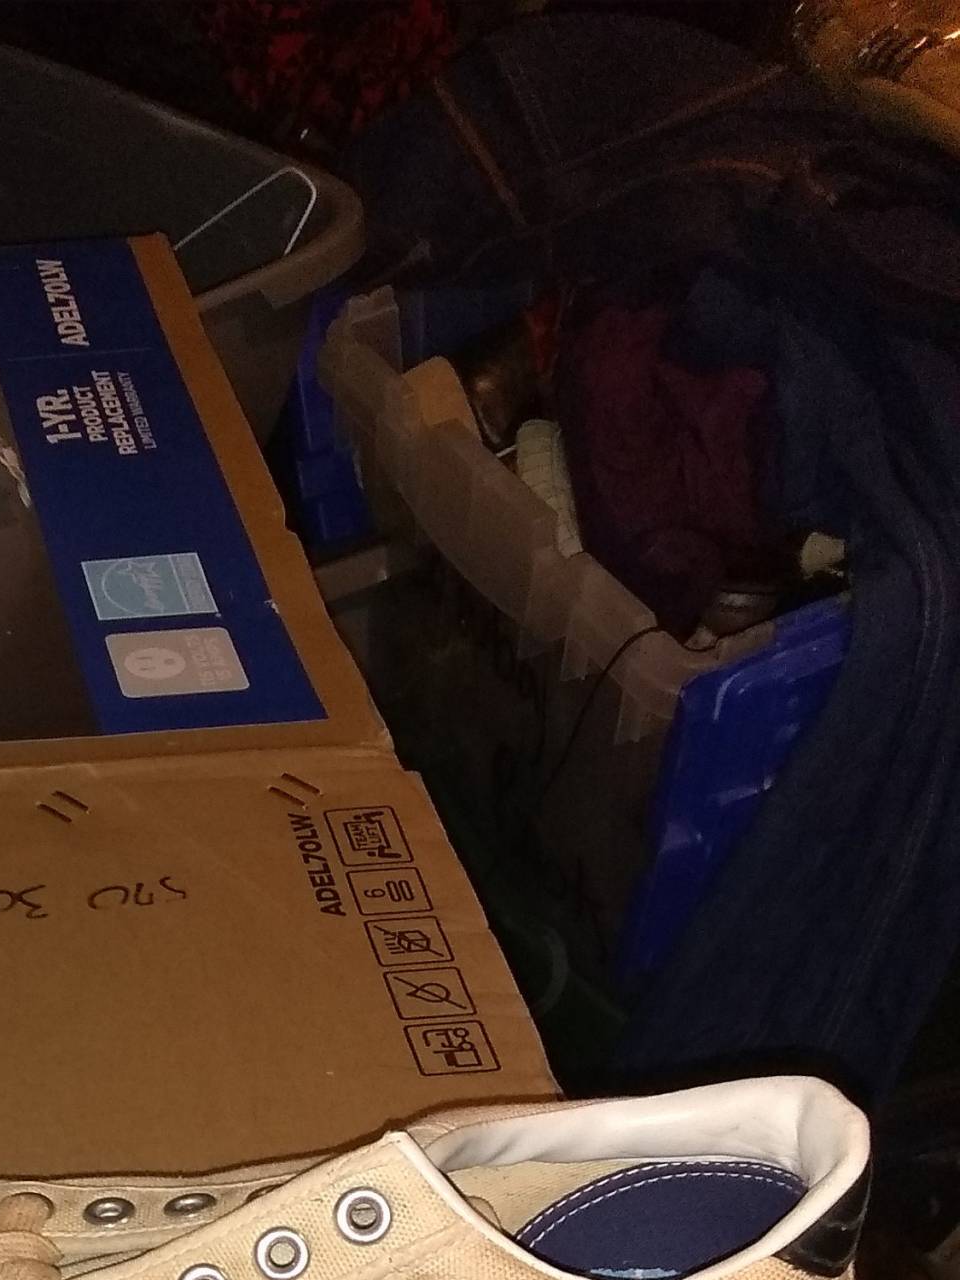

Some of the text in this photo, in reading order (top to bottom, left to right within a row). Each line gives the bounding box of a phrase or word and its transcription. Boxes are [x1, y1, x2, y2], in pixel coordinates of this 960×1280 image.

[35, 258, 90, 347] ADEL70LW
[35, 388, 82, 444] 1-YR.
[72, 385, 108, 443] PRODUCT
[91, 369, 138, 456] REPLACEMENT
[133, 415, 158, 450] LIMITED
[351, 823, 368, 849] TEAM
[365, 826, 382, 845] LIFT
[288, 813, 346, 917] ADEL70LW
[363, 888, 386, 898] 6
